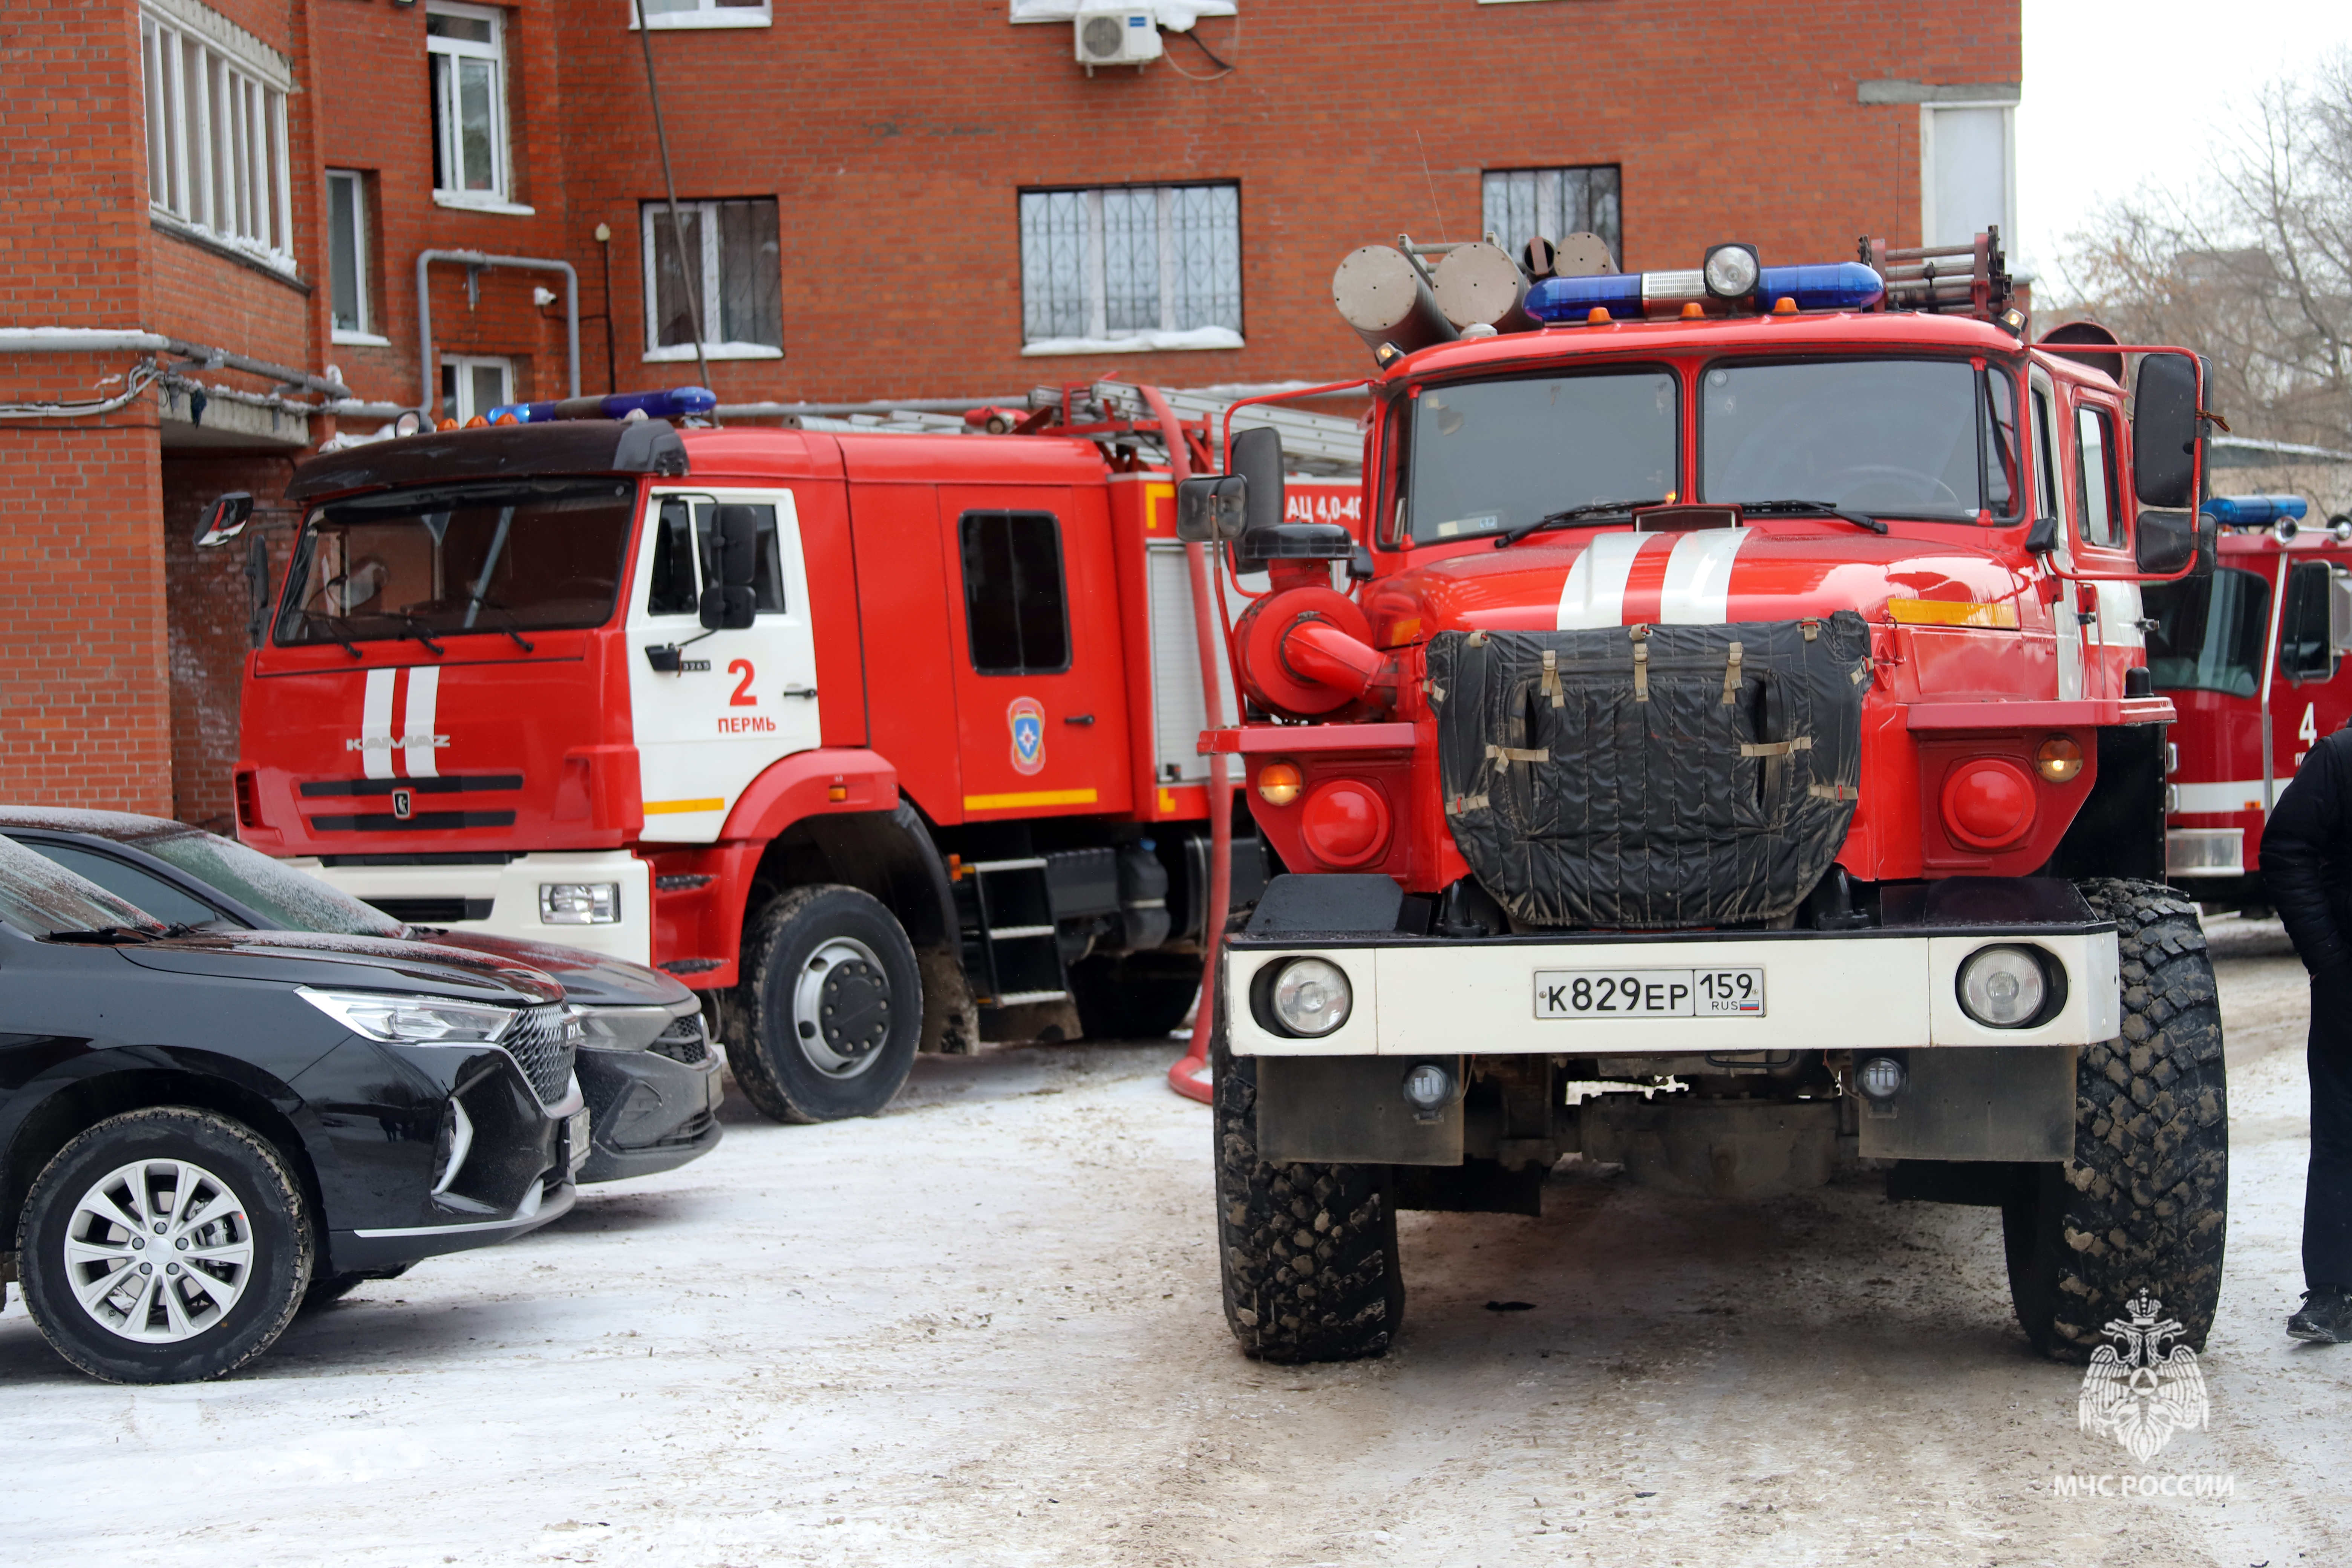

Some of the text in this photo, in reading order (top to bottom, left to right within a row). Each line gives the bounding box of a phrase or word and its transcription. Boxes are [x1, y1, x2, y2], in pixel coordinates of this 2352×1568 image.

[1286, 495, 1314, 523] АЦ
[728, 658, 758, 706] 2
[718, 717, 776, 733] ПЕРМЬ
[2299, 701, 2318, 749] 4
[346, 735, 451, 751] KAMAZ
[1549, 973, 1753, 1011] К829ЕР 159
[1712, 1001, 1738, 1011] RUS
